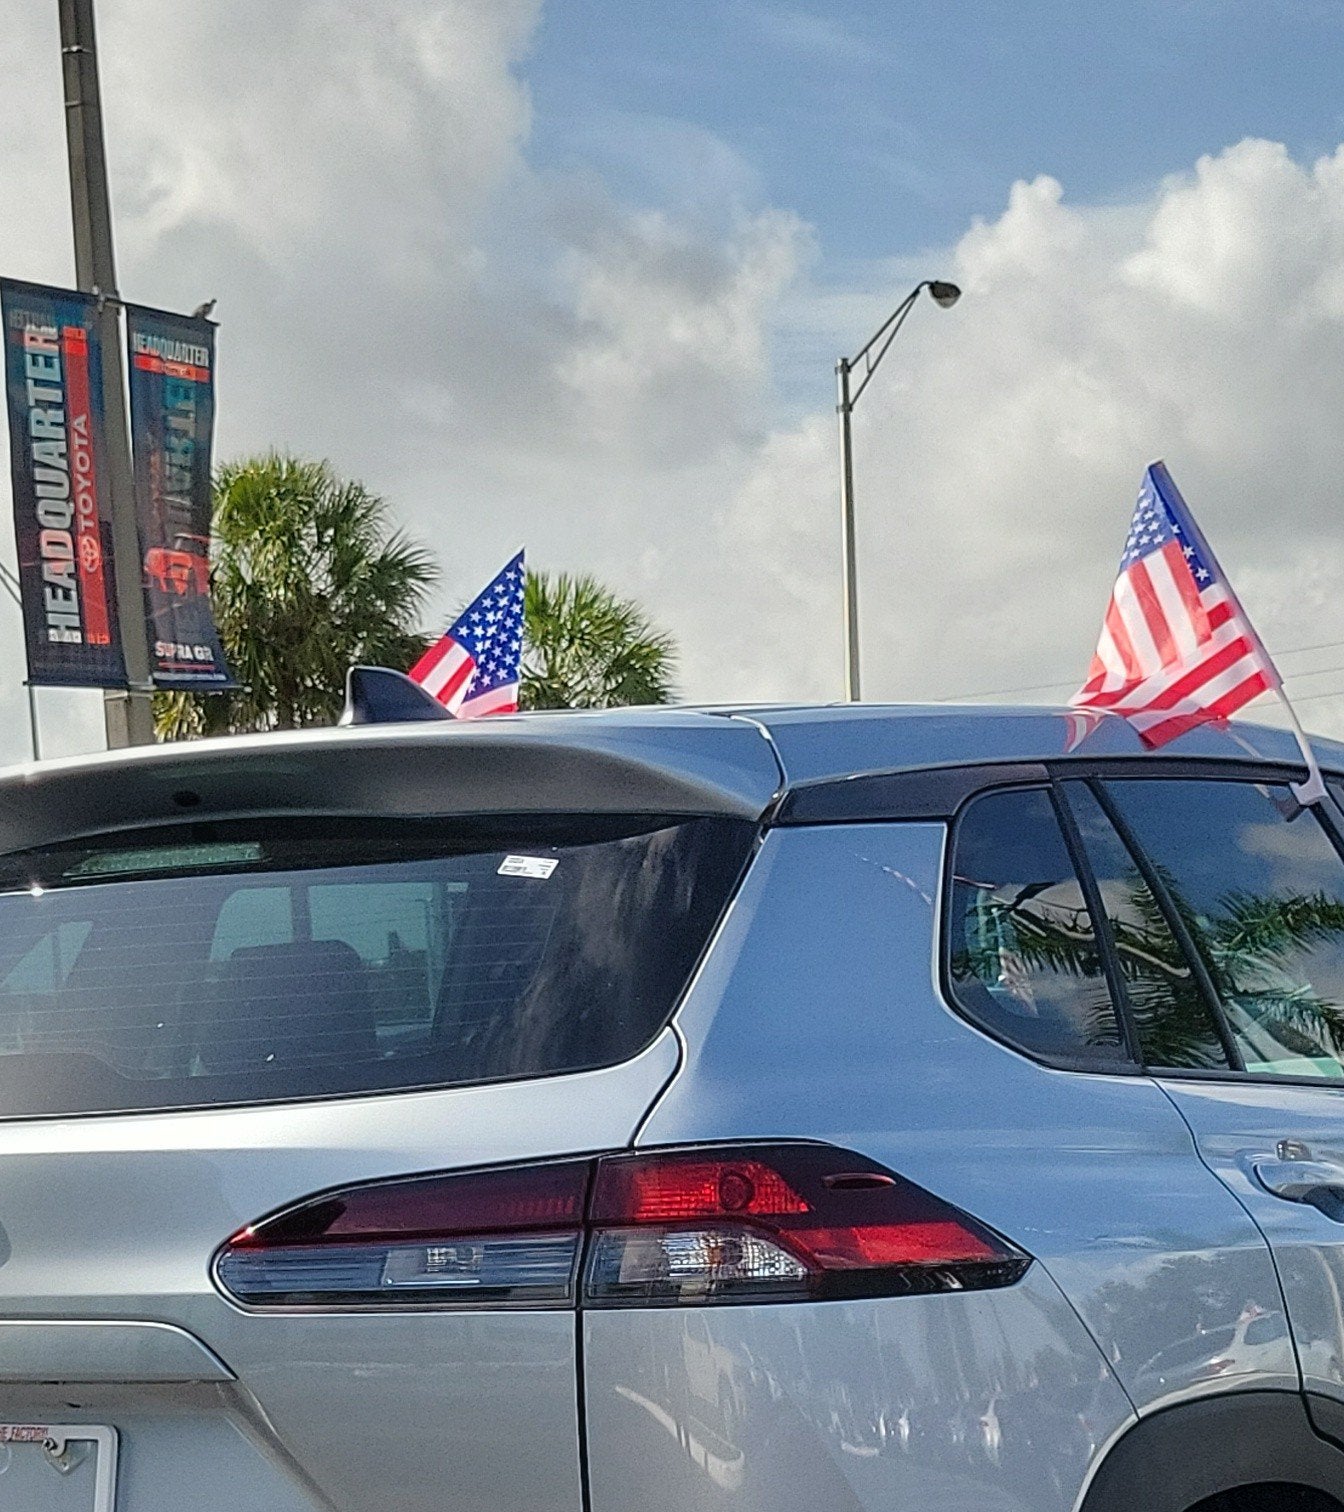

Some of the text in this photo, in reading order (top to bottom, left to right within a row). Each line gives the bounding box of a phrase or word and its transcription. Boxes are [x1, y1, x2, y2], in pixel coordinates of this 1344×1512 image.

[133, 332, 210, 368] HEADQUARTER
[24, 325, 83, 643] HEADQUARTER
[71, 414, 97, 532] TOYOTA
